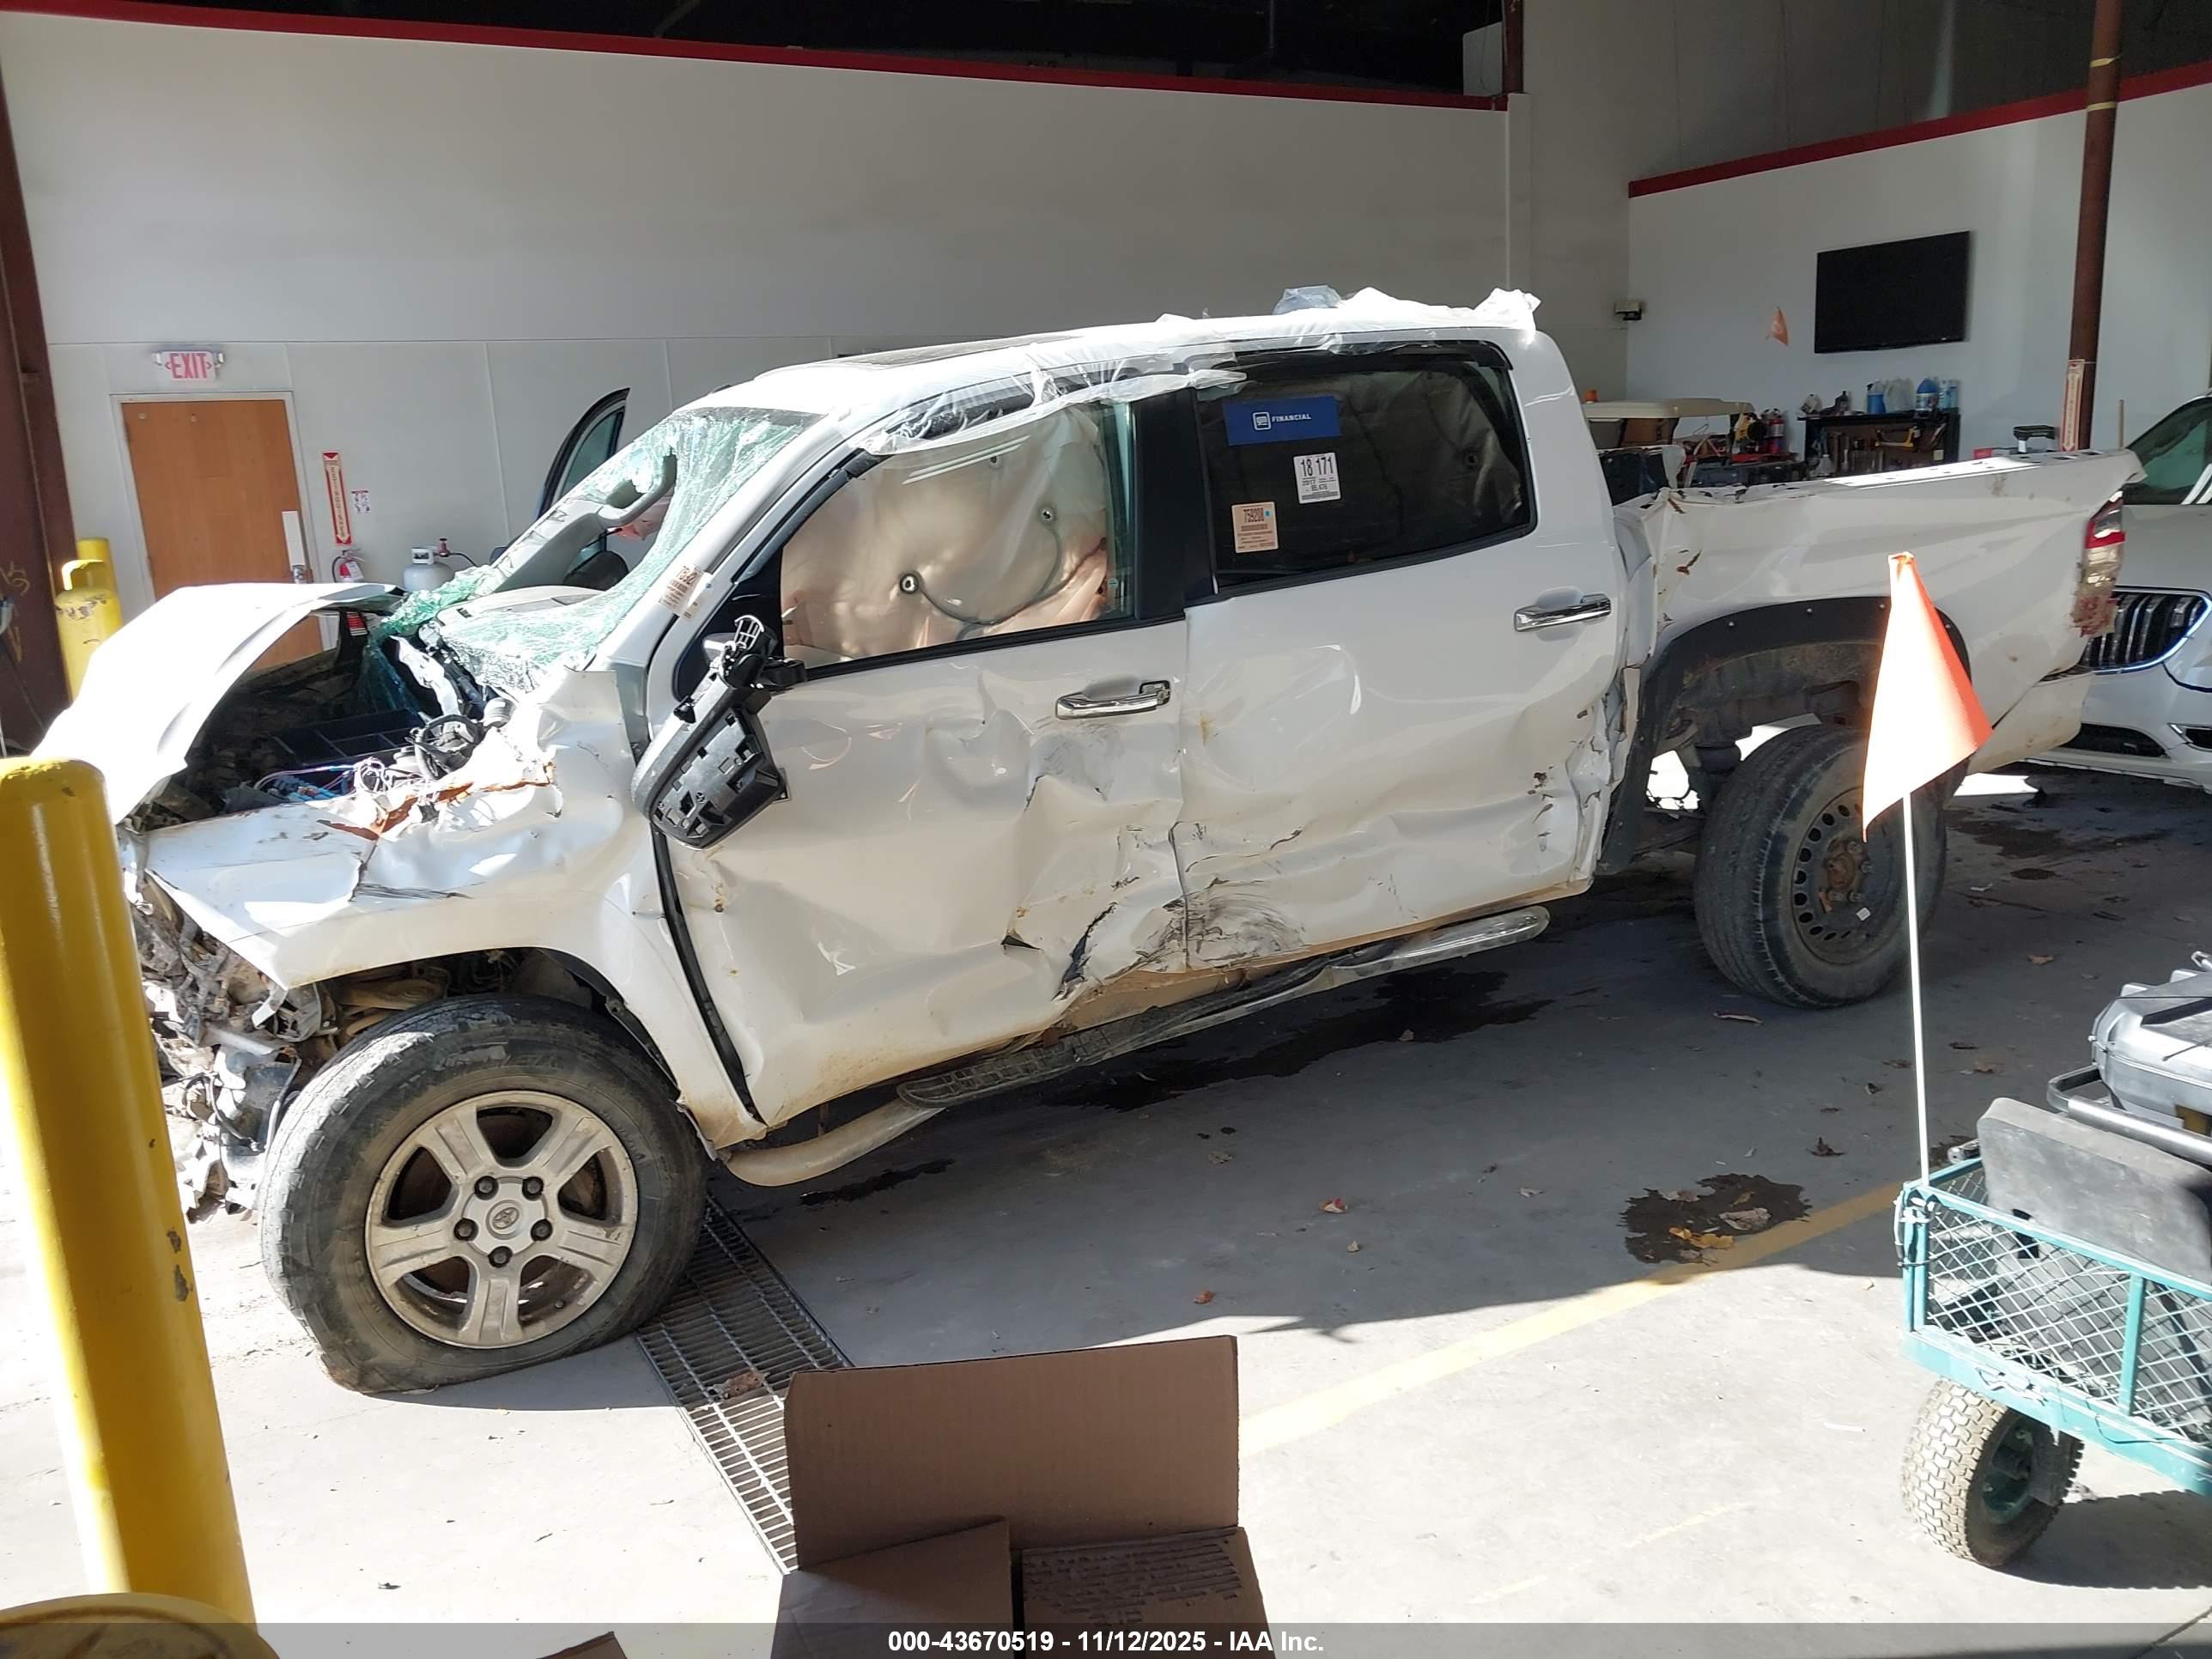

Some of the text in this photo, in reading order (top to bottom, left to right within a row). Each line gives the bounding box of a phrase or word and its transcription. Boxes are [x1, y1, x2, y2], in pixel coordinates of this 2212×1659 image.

[171, 353, 207, 379] EXIT
[1272, 414, 1311, 422] FINANCIAL
[1301, 456, 1334, 477] 18 171
